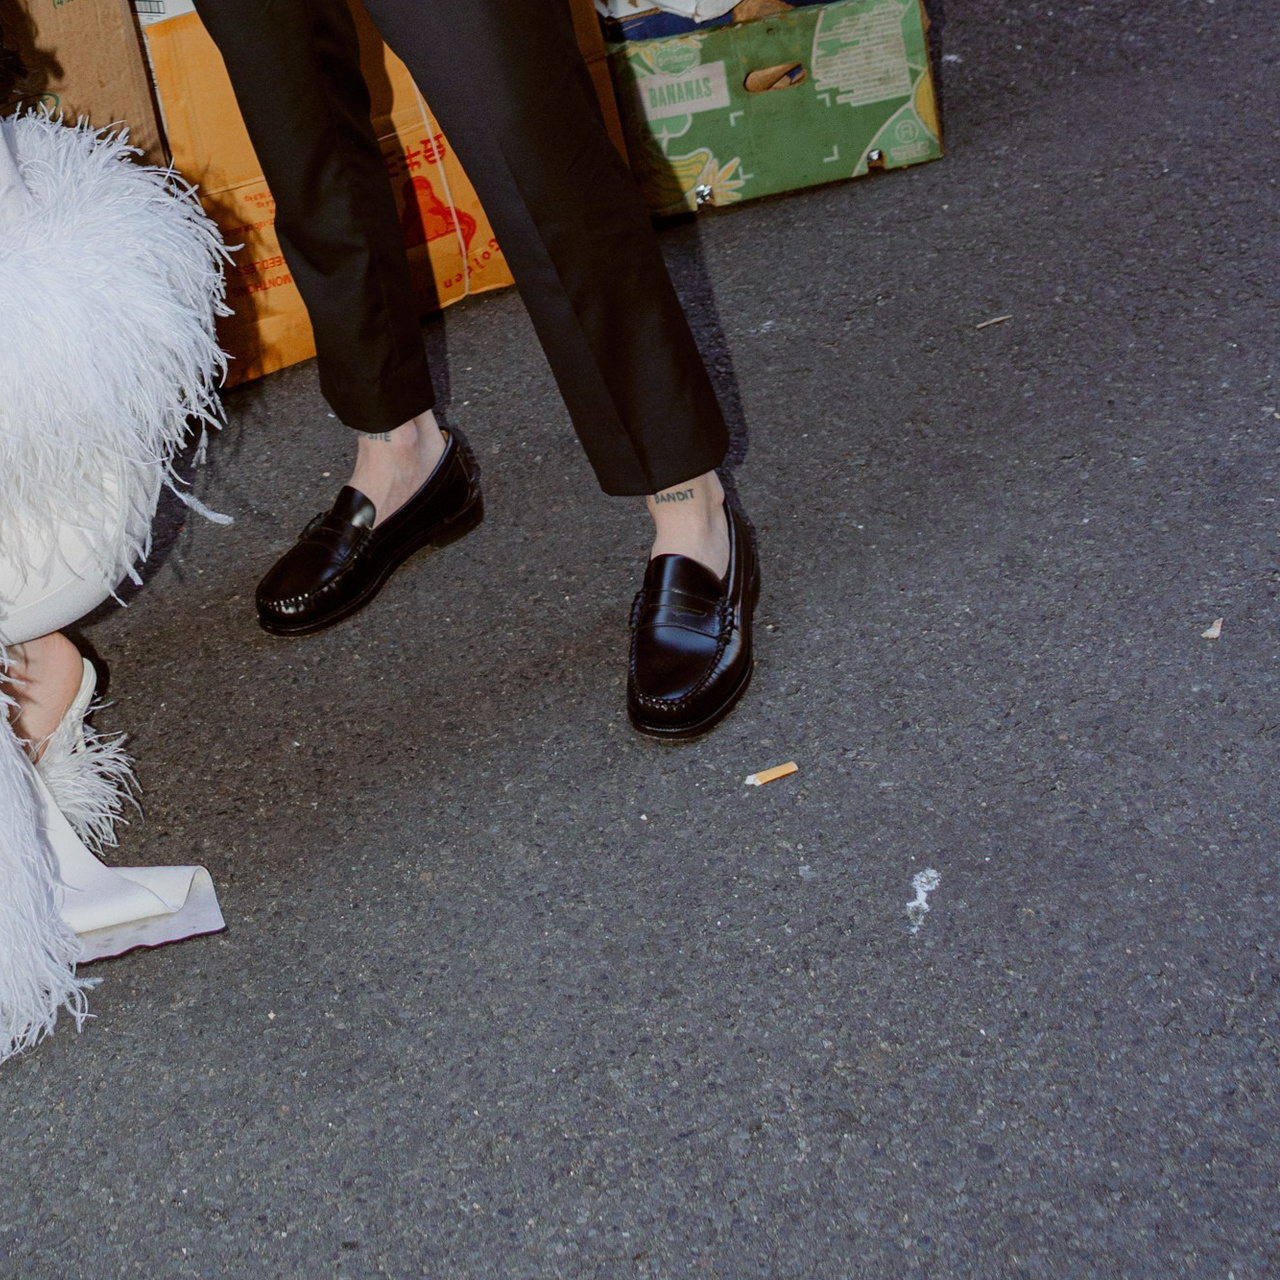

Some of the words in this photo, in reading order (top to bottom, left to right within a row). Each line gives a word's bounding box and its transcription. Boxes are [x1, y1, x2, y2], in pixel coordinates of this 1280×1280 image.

[648, 76, 714, 109] BANANAS
[443, 237, 503, 291] Golden
[232, 273, 293, 299] MONTHONG
[655, 489, 694, 504] BANDIT
